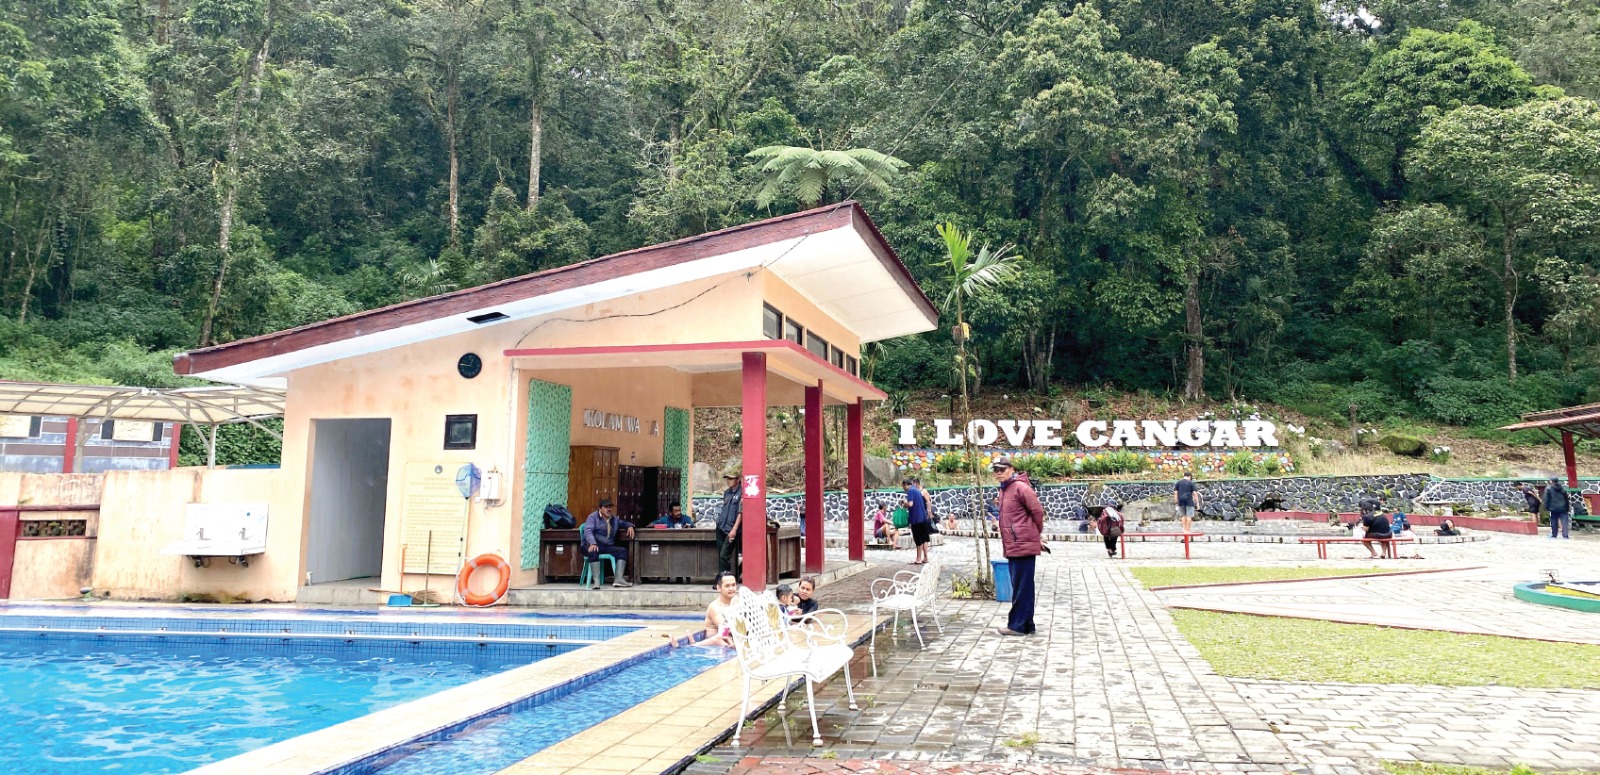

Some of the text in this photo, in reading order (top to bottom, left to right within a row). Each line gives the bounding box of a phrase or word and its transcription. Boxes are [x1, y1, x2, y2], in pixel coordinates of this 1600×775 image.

[897, 418, 1279, 447] I LOVE CANGAR
